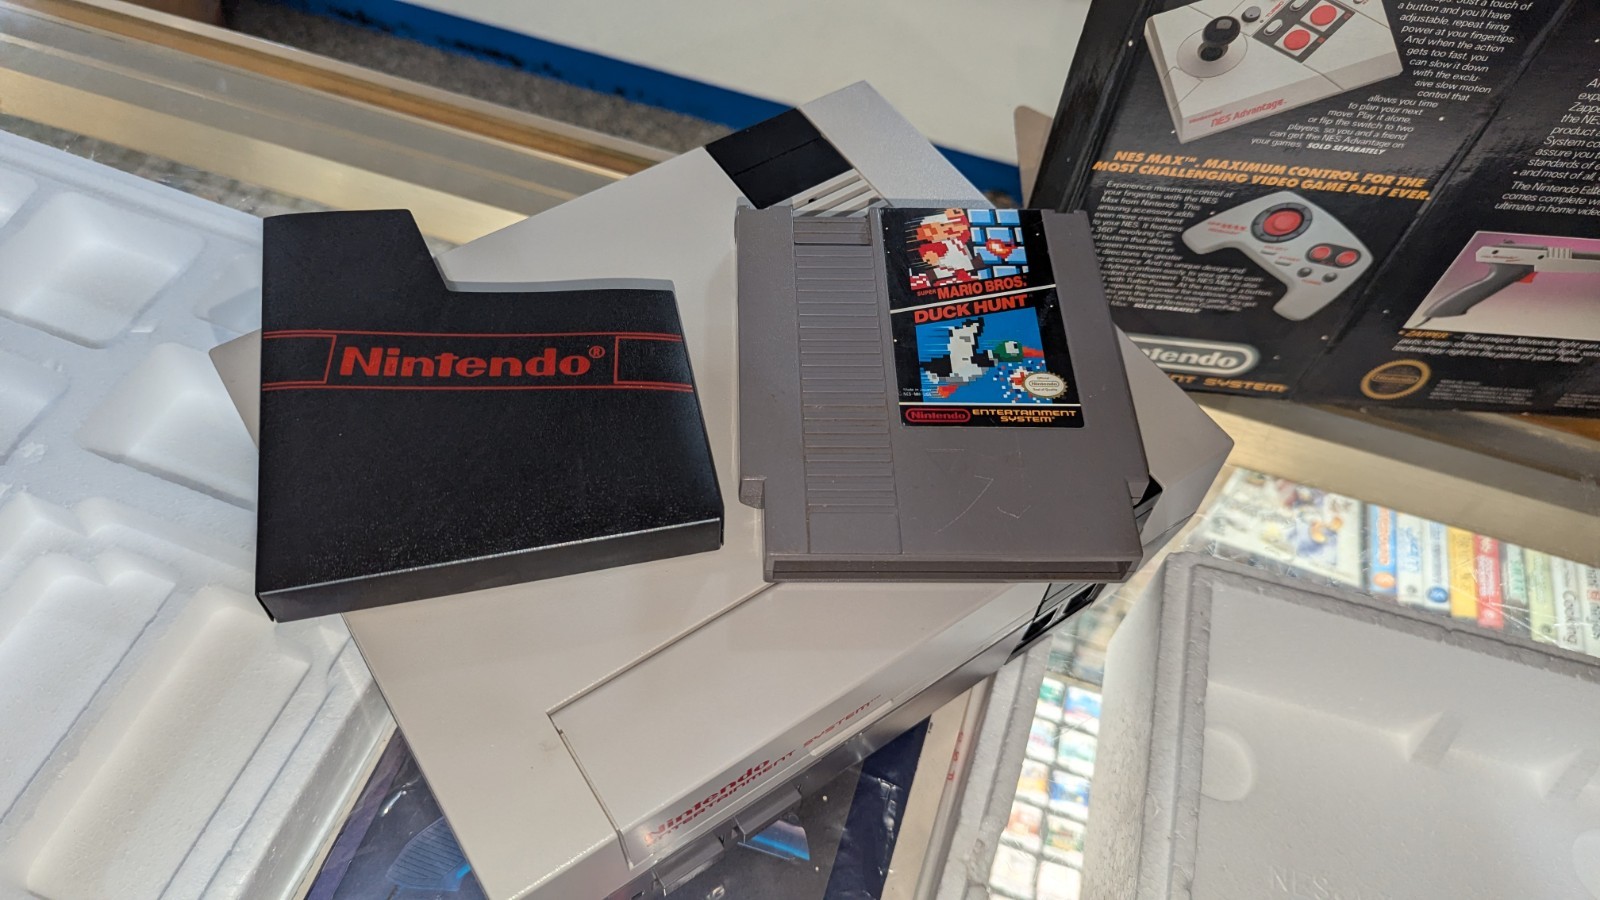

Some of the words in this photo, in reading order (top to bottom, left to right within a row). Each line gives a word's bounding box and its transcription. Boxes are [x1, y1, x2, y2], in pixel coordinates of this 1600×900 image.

[1398, 2, 1404, 10] a
[1406, 1, 1438, 12] button
[1440, 7, 1460, 15] and
[1487, 10, 1511, 20] have
[1520, 2, 1533, 11] of
[1401, 25, 1434, 34] power
[1435, 27, 1446, 36] at
[1447, 30, 1469, 38] your
[1452, 20, 1484, 29] repeat
[1485, 21, 1509, 33] firing
[1404, 35, 1427, 45] And
[1428, 38, 1455, 48] when
[1457, 40, 1473, 50] the
[1474, 43, 1504, 53] action
[1406, 48, 1428, 56] gets
[1430, 49, 1446, 58] too
[1470, 54, 1488, 62] you
[1409, 58, 1428, 66] can
[1428, 60, 1452, 69] slow
[1453, 62, 1460, 70] it
[1462, 63, 1489, 72] down
[1413, 69, 1434, 77] with
[1436, 71, 1451, 79] the
[1414, 79, 1434, 87] sive
[1435, 81, 1458, 90] slow
[1459, 84, 1492, 94] motion
[1368, 94, 1397, 104] allows
[1398, 99, 1416, 107] you
[1418, 100, 1438, 108] time
[1417, 90, 1450, 99] control
[1452, 92, 1470, 102] that
[1348, 102, 1358, 110] to
[1358, 102, 1379, 111] plan
[1380, 106, 1402, 114] your
[1402, 108, 1424, 116] next
[1356, 110, 1376, 120] Play
[1210, 114, 1232, 128] NES
[1318, 116, 1333, 124] flip
[1335, 118, 1350, 126] the
[1352, 120, 1382, 130] switch
[1384, 122, 1394, 130] to
[1560, 114, 1581, 124] the
[1336, 128, 1354, 136] you
[1354, 129, 1372, 138] and
[1381, 130, 1408, 140] friend
[1550, 126, 1596, 137] product
[1287, 132, 1304, 140] get
[1321, 134, 1342, 142] NES
[1342, 136, 1391, 148] Advantage
[1544, 135, 1586, 147] System
[1306, 142, 1332, 150] SOLD
[1332, 144, 1387, 155] SEPARATELY
[1535, 148, 1572, 158] assure
[1572, 151, 1594, 160] you
[1114, 151, 1146, 162] NES
[1202, 158, 1287, 176] MAXIMUM
[1288, 166, 1359, 182] CONTROL
[1361, 173, 1395, 185] FOR
[1396, 176, 1429, 188] THE
[1528, 158, 1580, 170] standards
[1580, 160, 1596, 170] of
[1092, 160, 1138, 174] MOST
[1138, 164, 1249, 184] CHALLENGING
[1251, 174, 1299, 188] VIDEO
[1300, 180, 1346, 192] GAME
[1346, 184, 1389, 196] PLAY
[1520, 168, 1542, 177] and
[1540, 170, 1569, 180] most
[1570, 170, 1584, 180] of
[1106, 180, 1153, 191] Experience
[1154, 186, 1193, 194] maximum
[1194, 189, 1224, 198] control
[1512, 180, 1532, 191] The
[1532, 182, 1580, 194] Nintendo
[1100, 195, 1120, 204] Max
[1120, 197, 1140, 205] from
[1184, 202, 1201, 211] This
[1124, 190, 1162, 200] fingertips
[1200, 196, 1219, 204] NES
[1502, 192, 1538, 202] comes
[1538, 195, 1587, 205] complete
[1494, 202, 1536, 212] ultimate
[1535, 204, 1546, 212] in
[1546, 204, 1576, 215] home
[936, 282, 984, 300] MARIO
[914, 302, 970, 324] DUCK
[974, 294, 1028, 314] HUNT
[1203, 376, 1289, 393] SYSTEM
[911, 410, 968, 420] Nintendo
[972, 408, 1077, 418] ENTERTAINMENT
[645, 760, 770, 843] Nintendo
